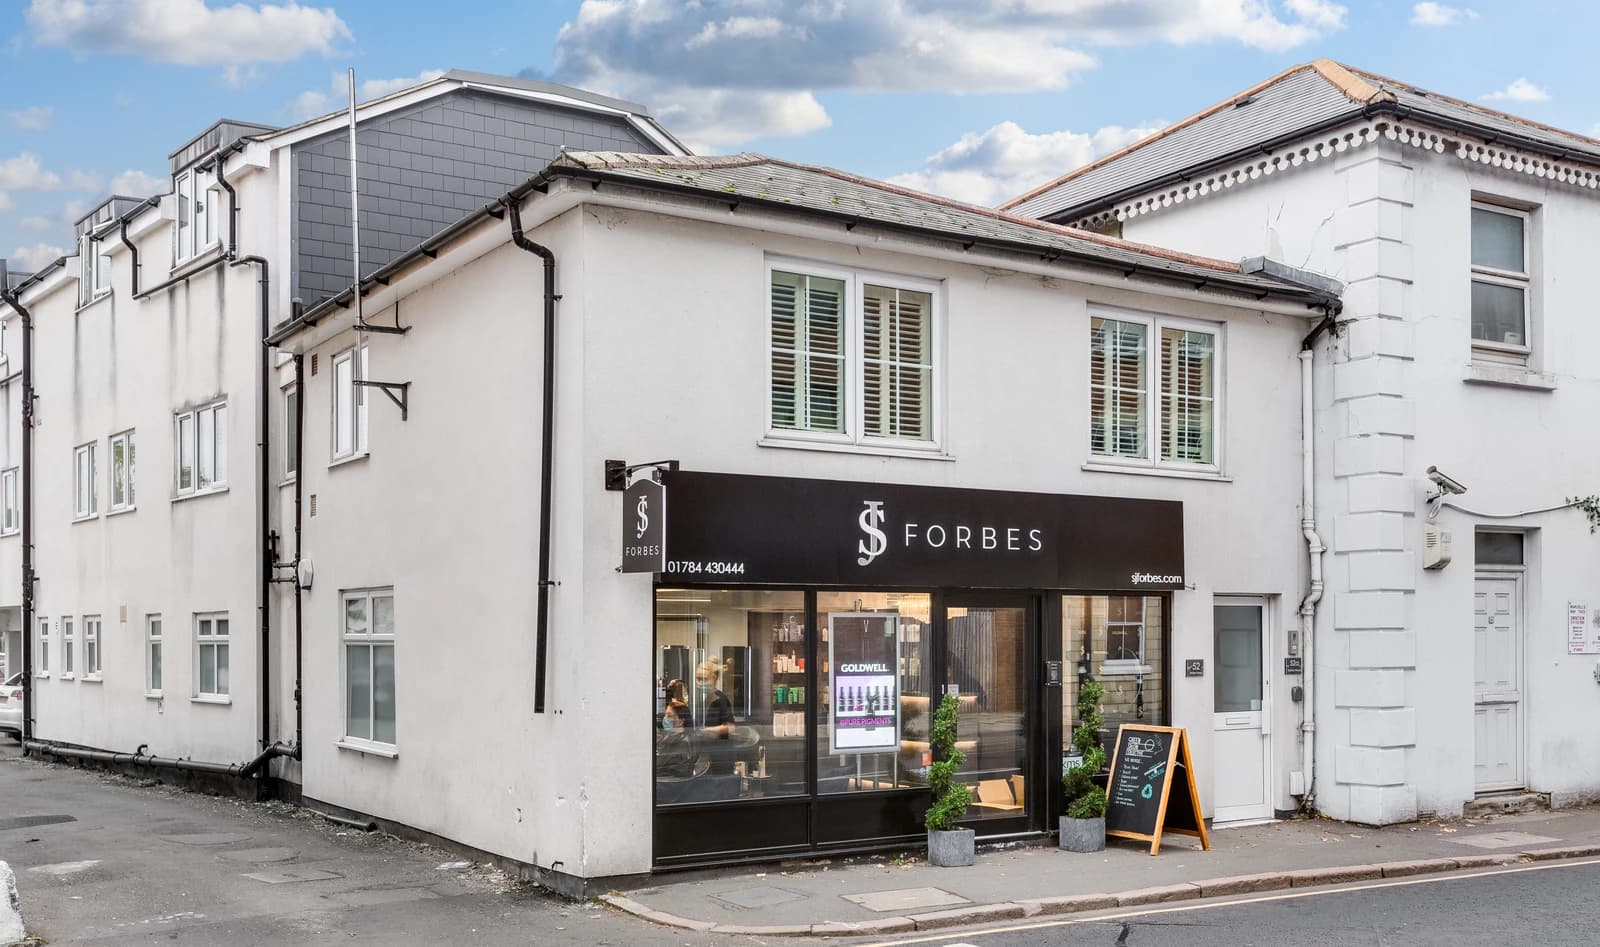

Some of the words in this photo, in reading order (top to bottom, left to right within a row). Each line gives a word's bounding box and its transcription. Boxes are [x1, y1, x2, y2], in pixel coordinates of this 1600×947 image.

[905, 523, 1042, 551] FORBES
[625, 545, 660, 557] FORBES
[667, 561, 702, 573] 01784
[704, 562, 745, 574] 430444
[1131, 572, 1182, 584] sjforbes.com
[841, 663, 888, 673] GOLDWELL
[1192, 662, 1201, 670] 52
